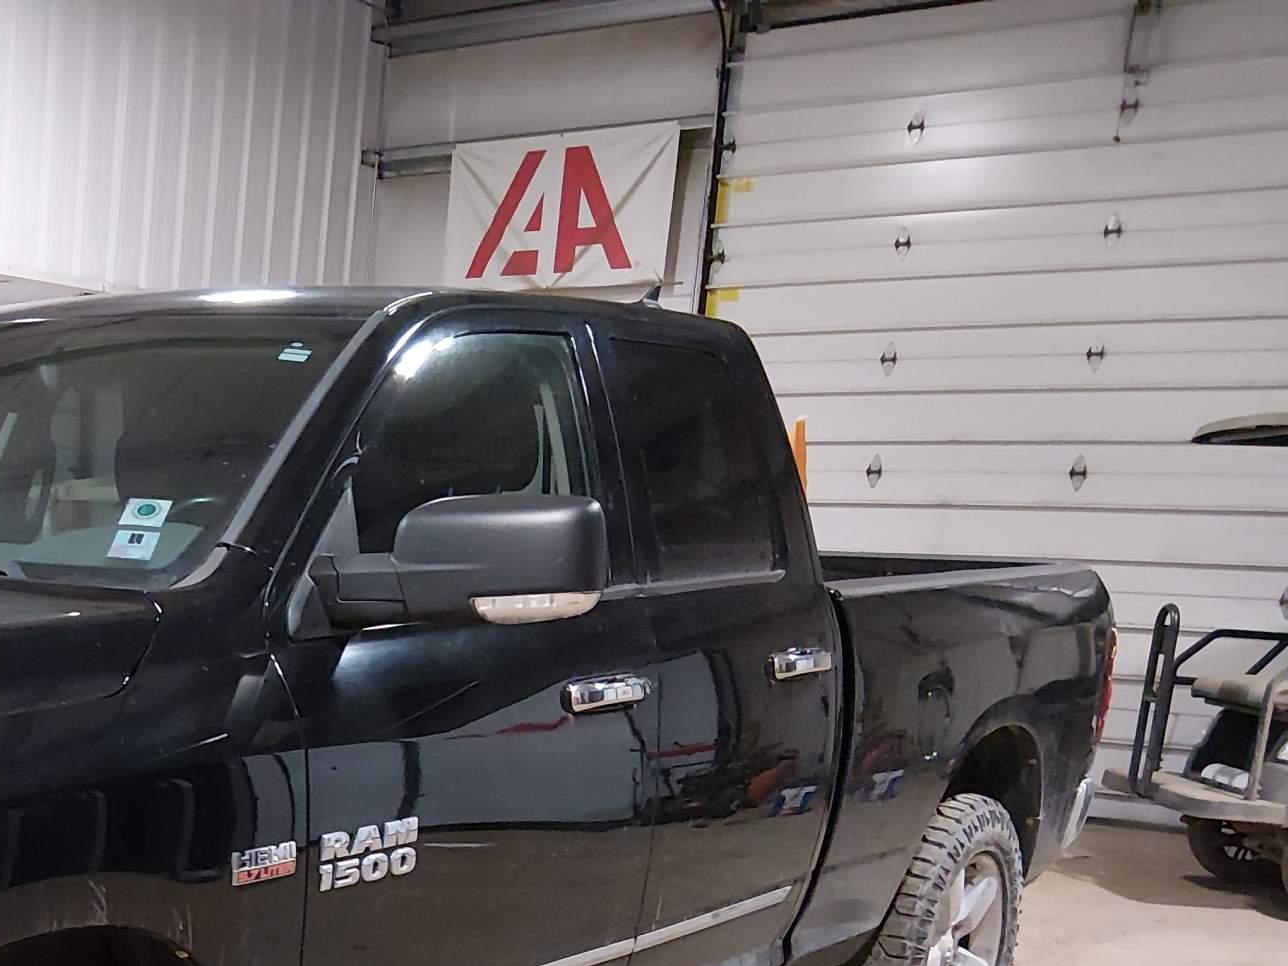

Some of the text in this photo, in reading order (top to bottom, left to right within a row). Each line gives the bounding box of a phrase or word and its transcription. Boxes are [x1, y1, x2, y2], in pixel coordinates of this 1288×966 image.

[231, 841, 296, 871] HEMI
[320, 816, 419, 861] RAM
[319, 846, 417, 892] 1500
